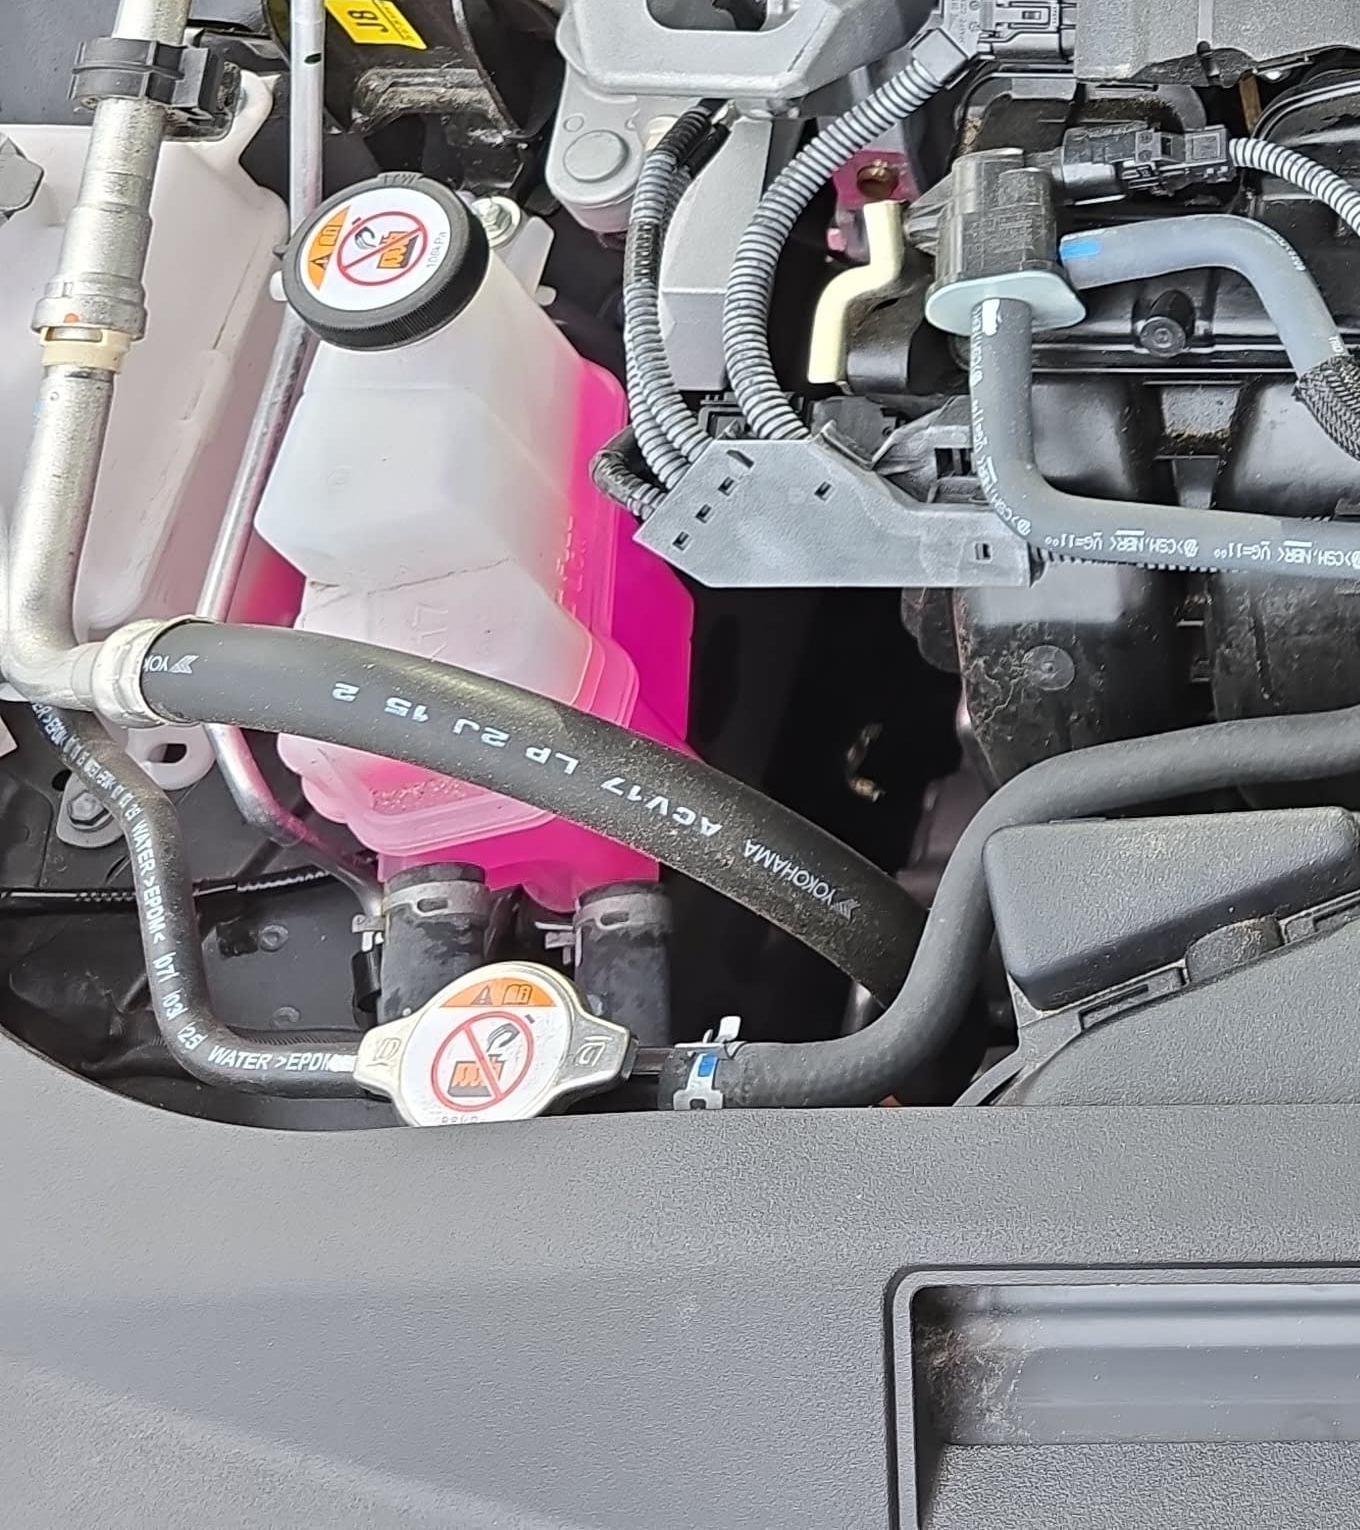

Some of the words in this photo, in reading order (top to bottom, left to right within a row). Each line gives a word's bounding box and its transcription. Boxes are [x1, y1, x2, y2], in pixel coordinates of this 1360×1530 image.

[347, 9, 389, 33] J8
[331, 681, 360, 703] 2
[383, 696, 430, 723] 15
[452, 717, 511, 748] 2J
[524, 745, 580, 775] LP
[600, 776, 723, 837] ACV17
[131, 819, 156, 877] WATER
[743, 838, 839, 907] YOKOHAMA
[207, 1044, 273, 1071] WATER
